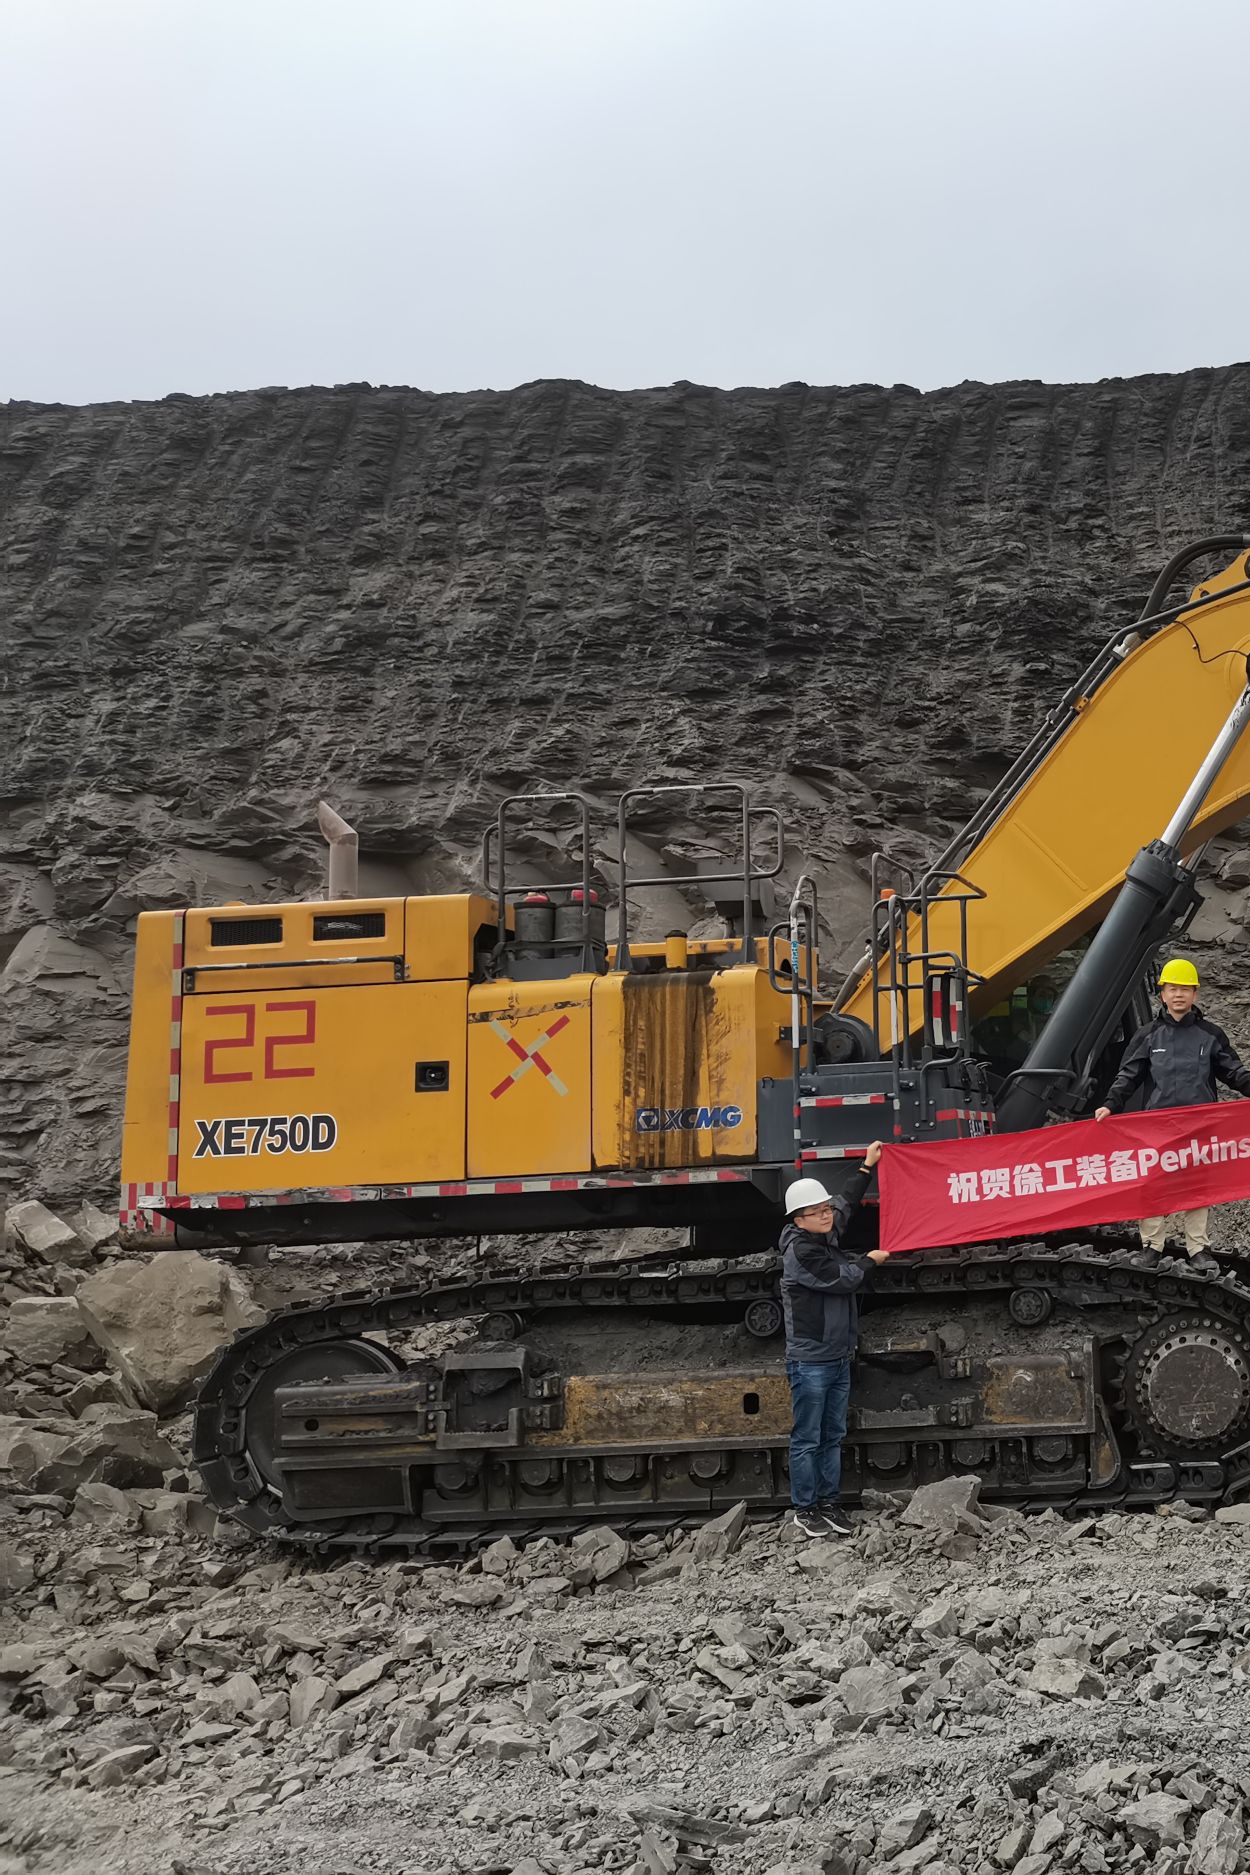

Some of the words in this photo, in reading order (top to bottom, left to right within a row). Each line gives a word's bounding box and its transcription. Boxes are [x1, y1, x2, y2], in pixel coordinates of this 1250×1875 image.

[203, 1000, 316, 1084] 22
[192, 1113, 338, 1158] XE750D
[660, 1105, 743, 1132] XCMG
